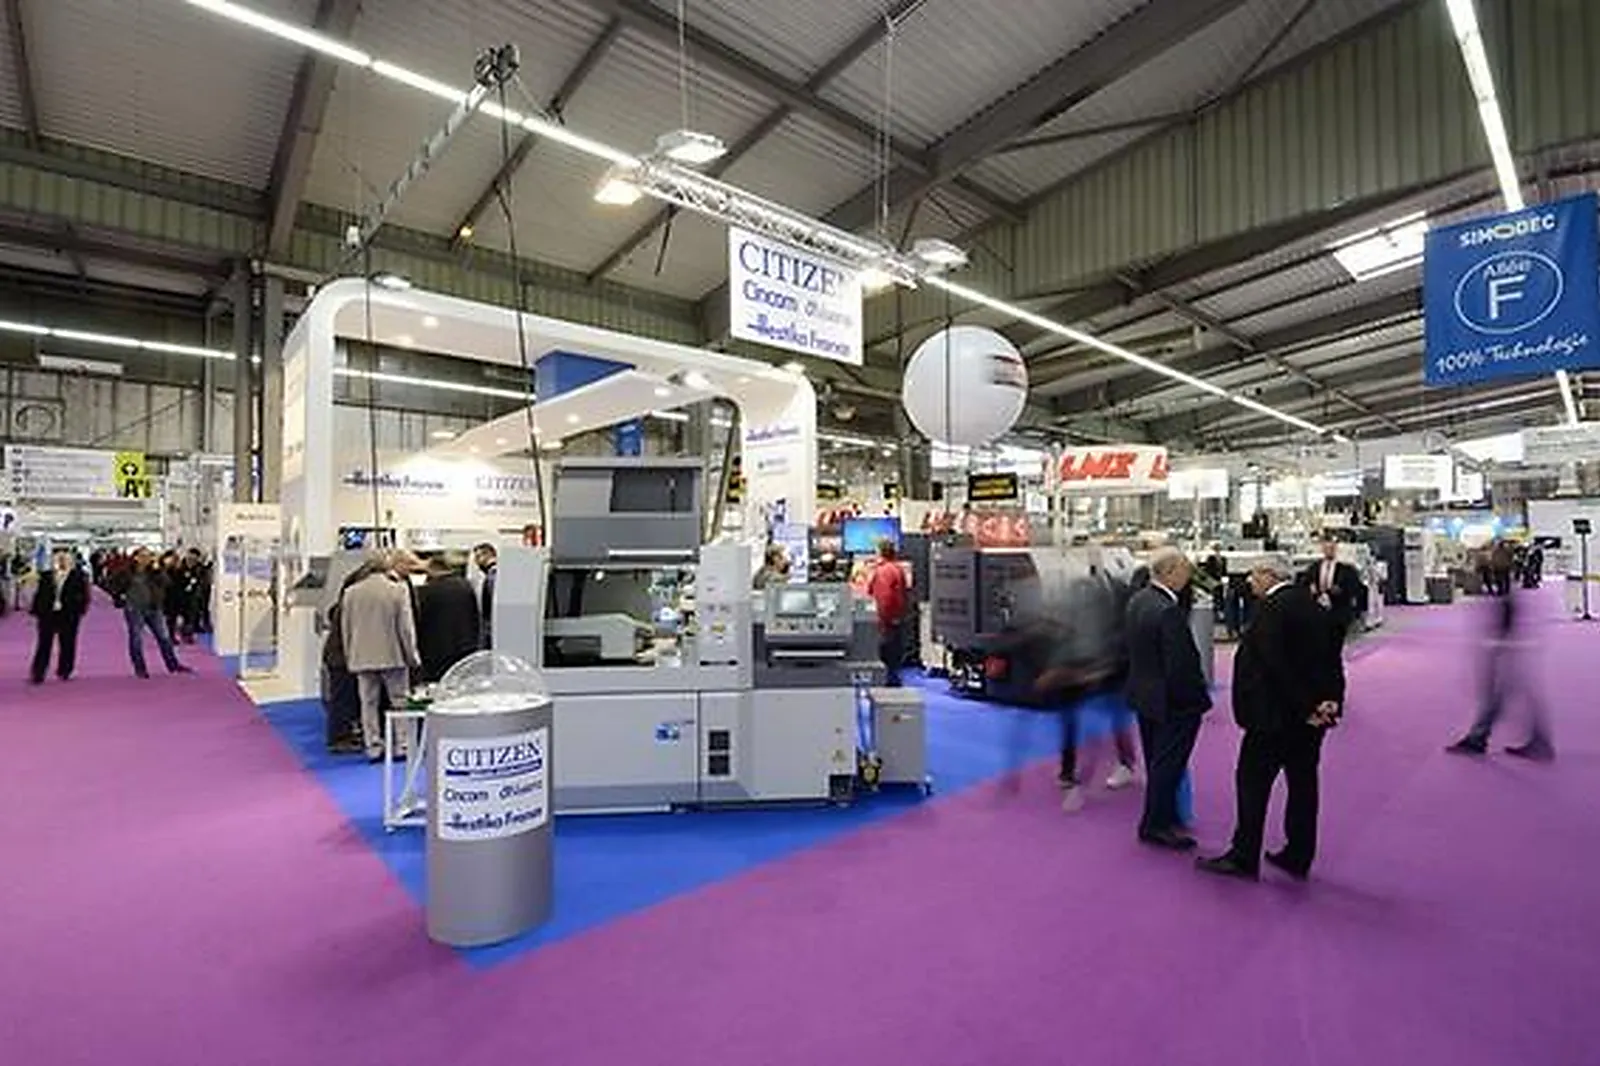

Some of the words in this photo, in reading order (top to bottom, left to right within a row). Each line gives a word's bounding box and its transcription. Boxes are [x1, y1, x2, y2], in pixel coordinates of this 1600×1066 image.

[1459, 213, 1556, 247] SIMODEC
[739, 240, 850, 297] CITIZE
[1489, 273, 1527, 319] F
[1435, 349, 1484, 374] 100%
[447, 740, 541, 768] CITIZEN
